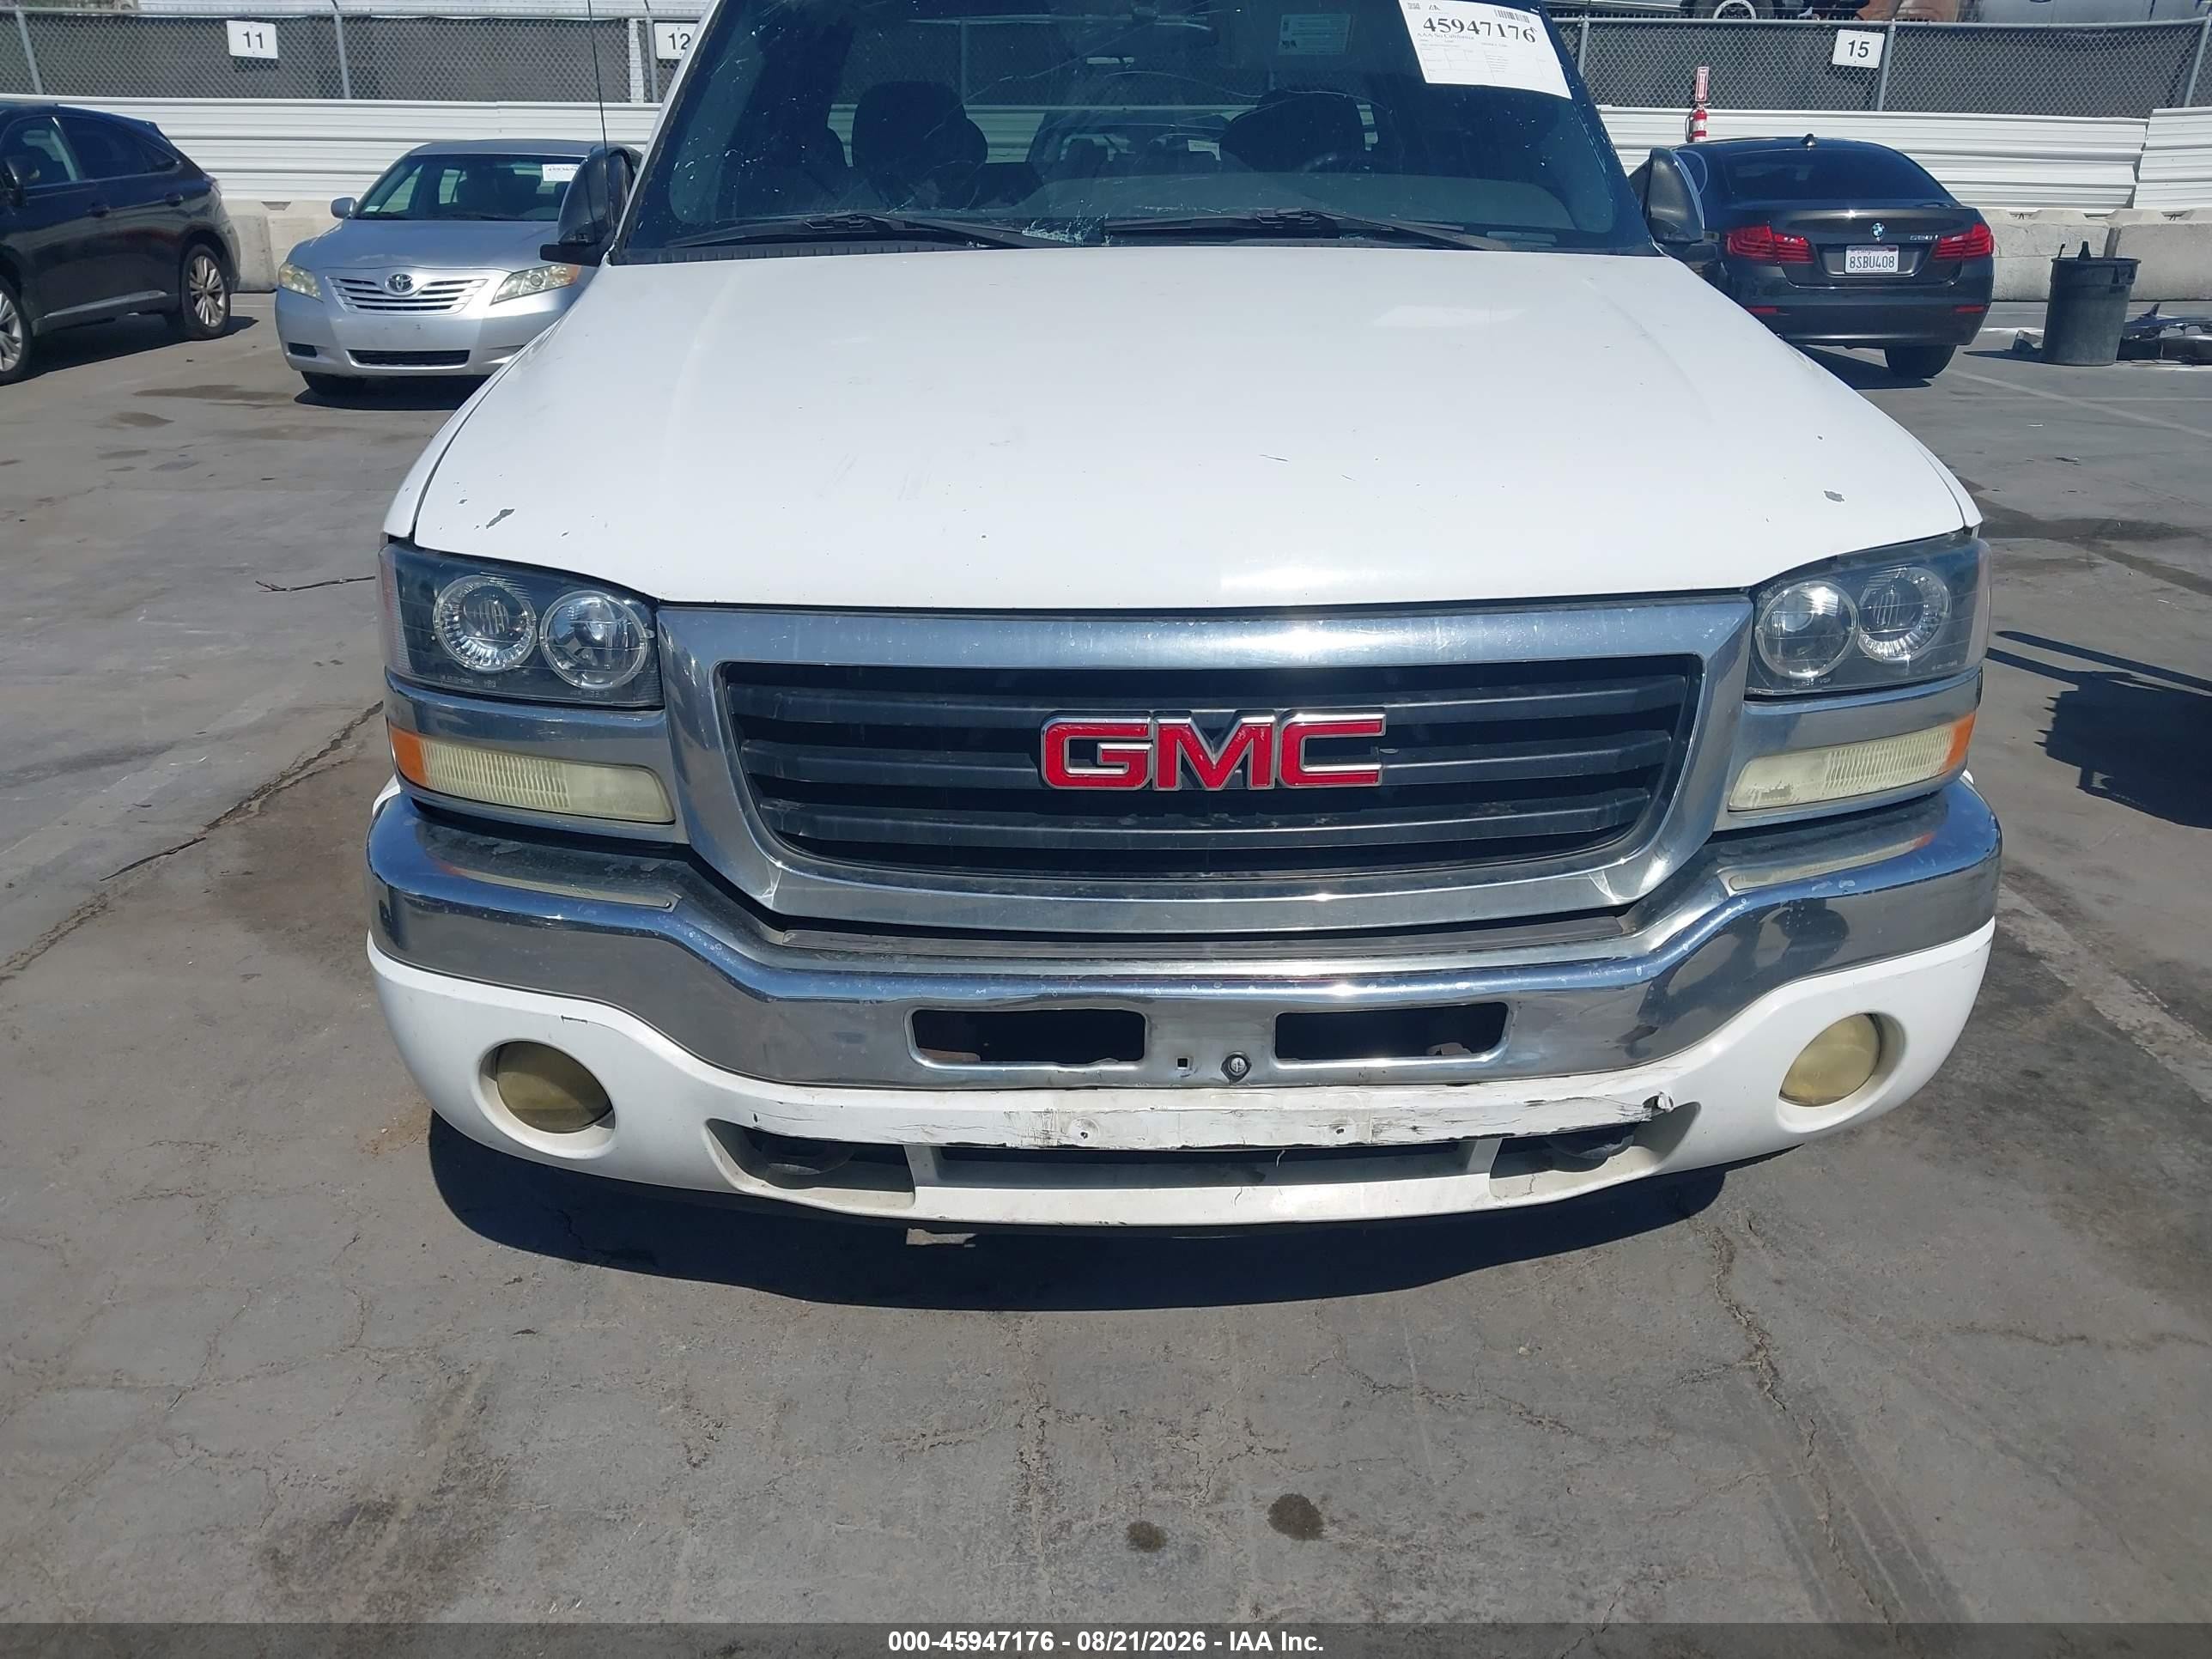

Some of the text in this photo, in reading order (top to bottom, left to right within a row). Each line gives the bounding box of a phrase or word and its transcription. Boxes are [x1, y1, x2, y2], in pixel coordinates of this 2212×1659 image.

[1423, 16, 1537, 43] 45947176
[242, 30, 263, 49] 11
[667, 32, 691, 50] 12
[1848, 40, 1870, 58] 15
[1849, 255, 1895, 269] 8SBU408
[1040, 712, 1387, 793] GMC
